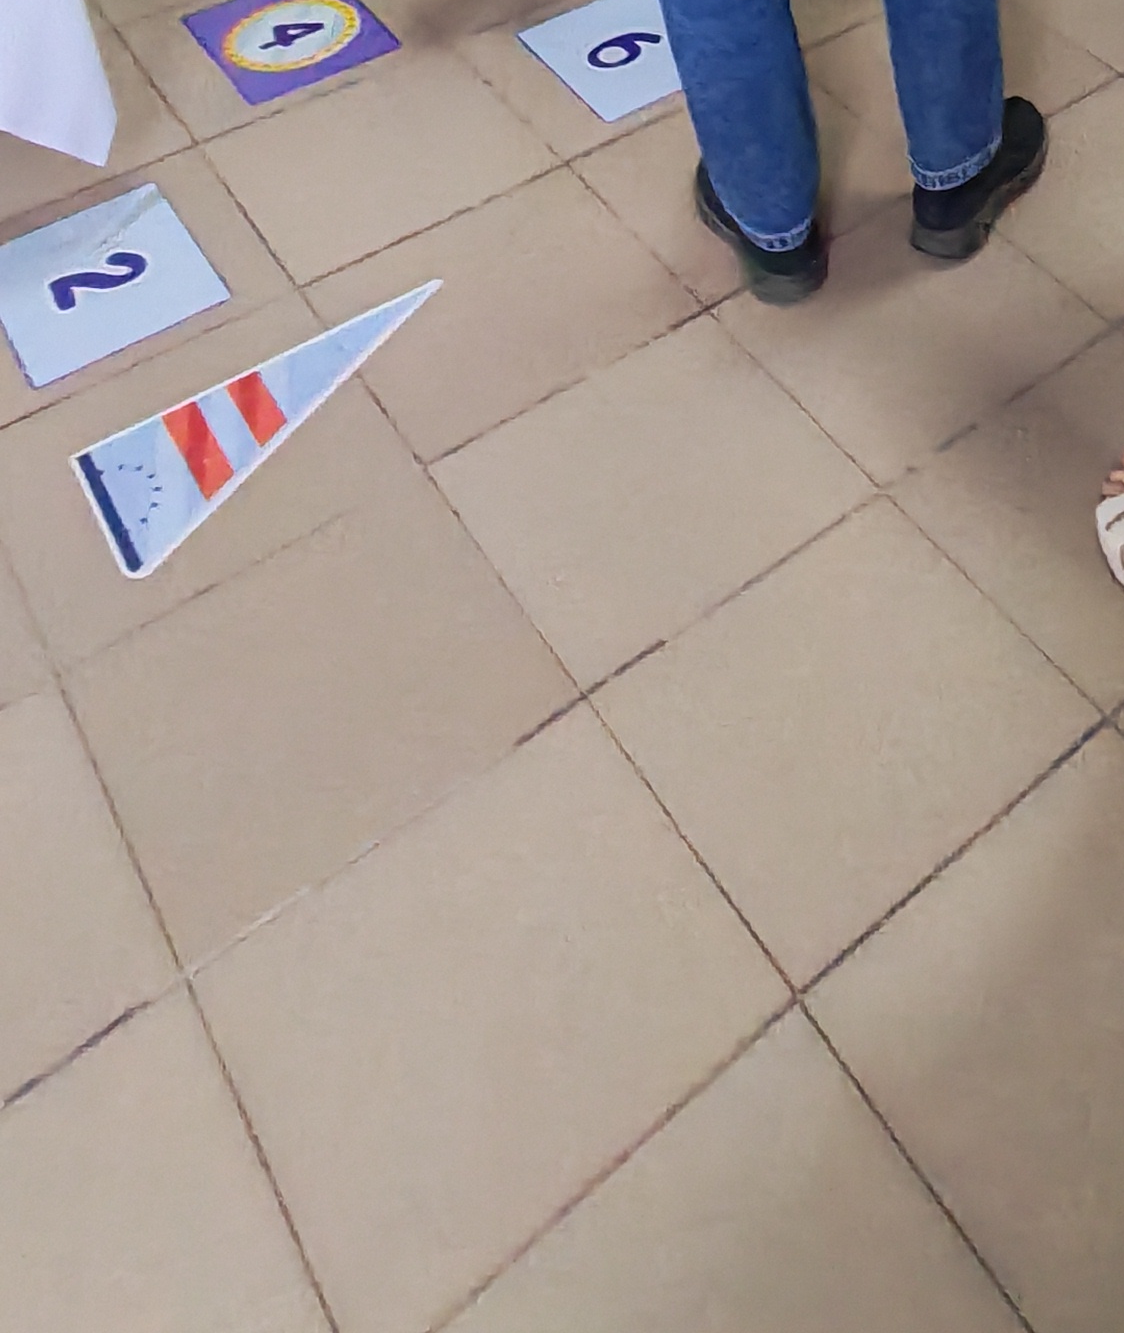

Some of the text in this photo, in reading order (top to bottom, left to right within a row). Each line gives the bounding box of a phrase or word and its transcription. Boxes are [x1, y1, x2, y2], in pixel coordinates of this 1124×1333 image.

[257, 22, 325, 50] 4
[587, 32, 662, 69] 6
[49, 251, 149, 311] 2
